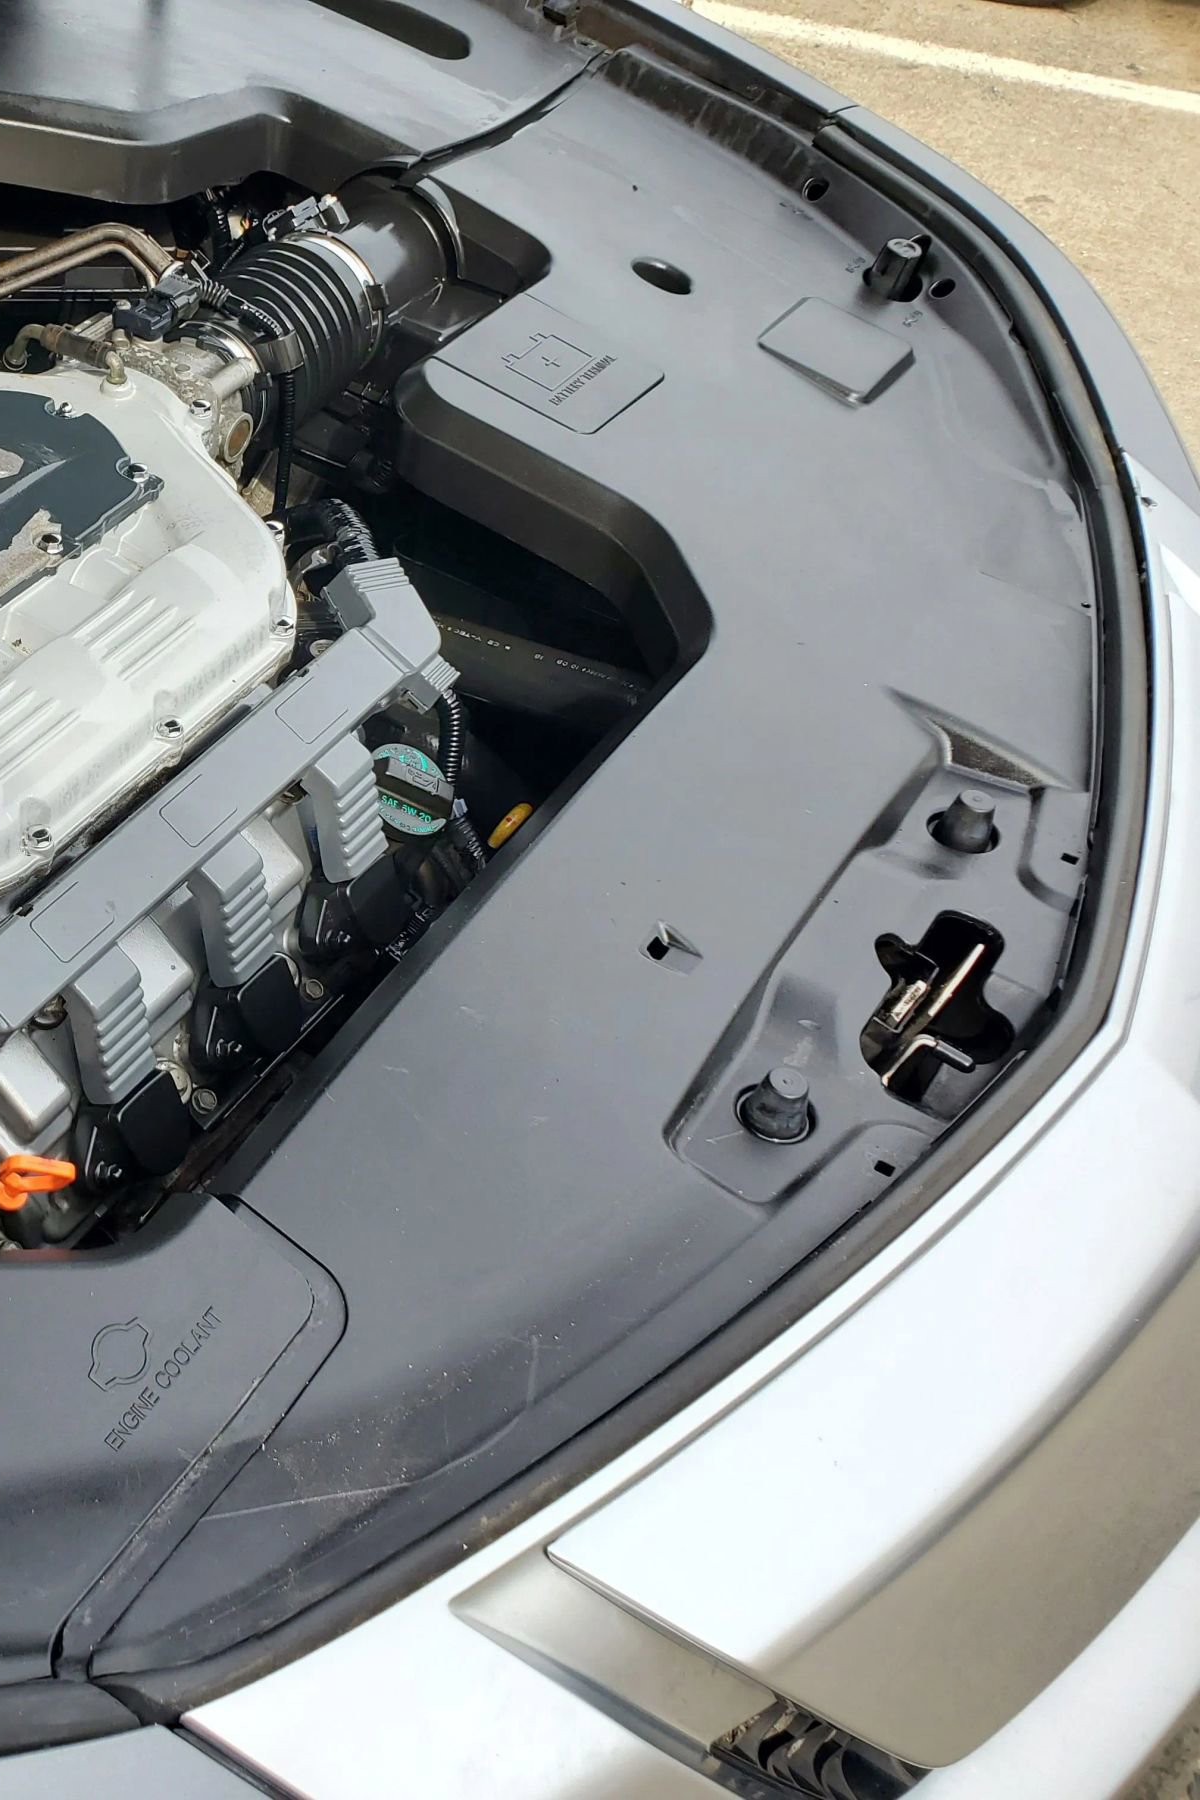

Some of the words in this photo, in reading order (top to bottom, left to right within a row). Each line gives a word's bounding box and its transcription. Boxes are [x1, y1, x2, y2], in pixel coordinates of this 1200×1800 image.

[548, 377, 585, 406] BATTERY
[103, 1386, 160, 1452] ENGINE
[154, 1306, 222, 1389] COOLANT
